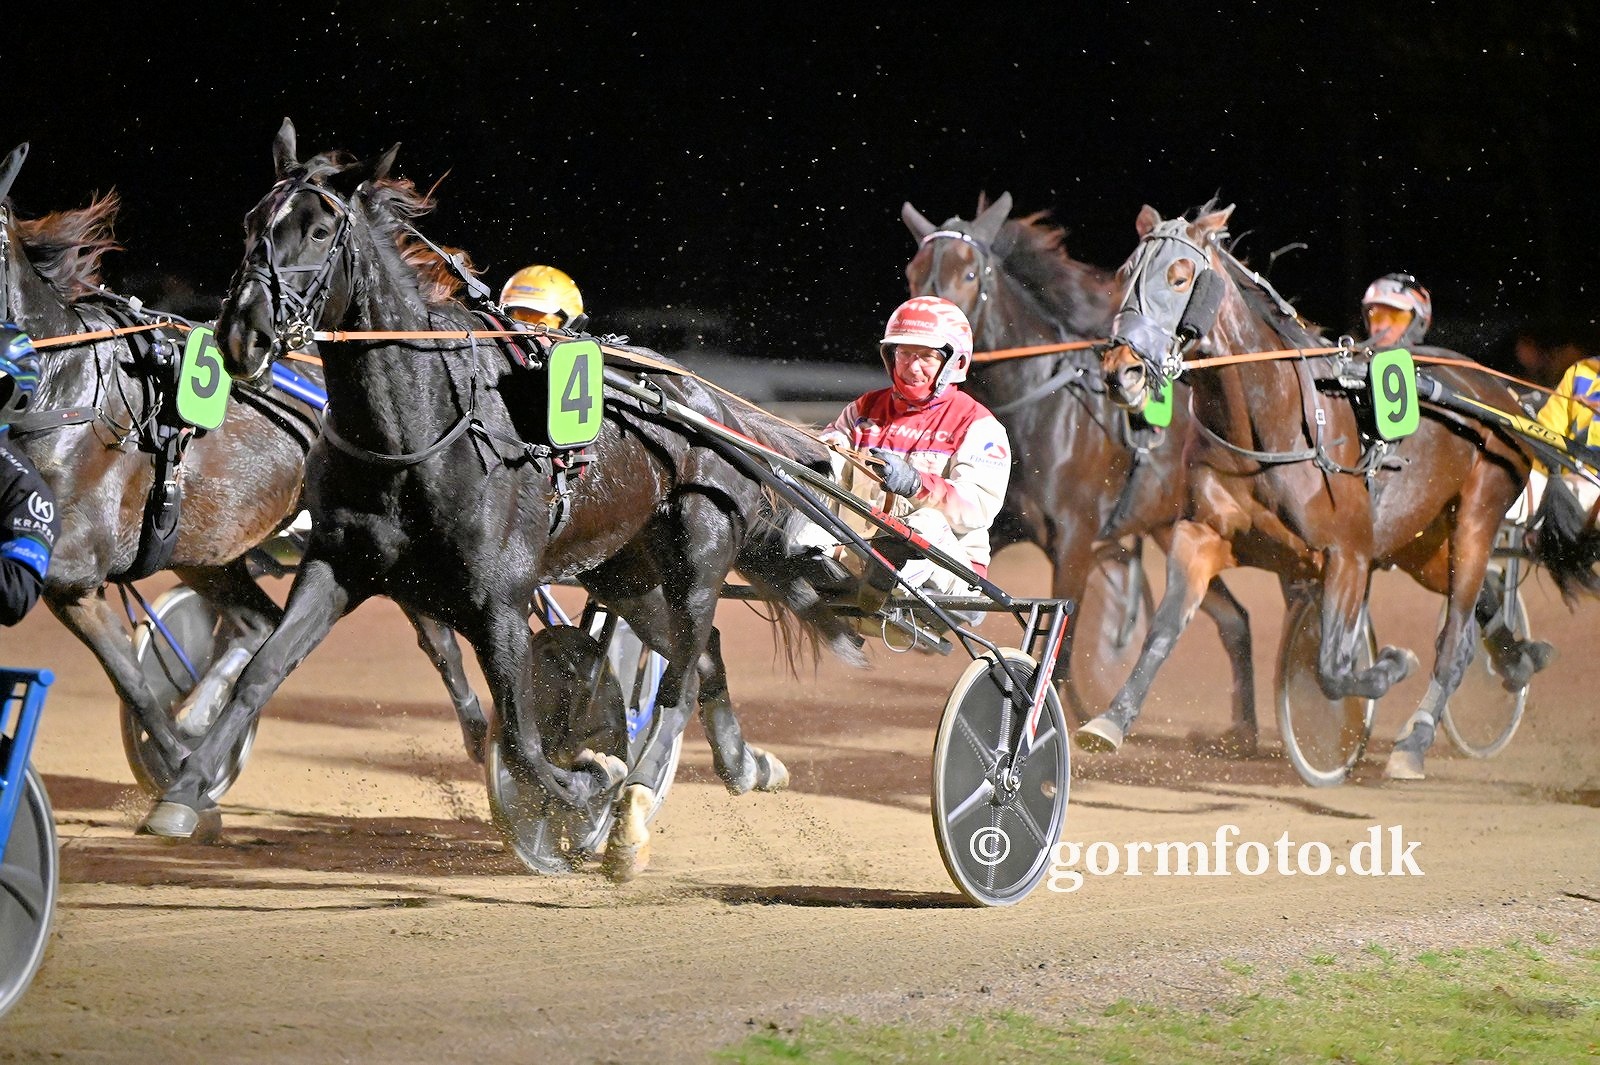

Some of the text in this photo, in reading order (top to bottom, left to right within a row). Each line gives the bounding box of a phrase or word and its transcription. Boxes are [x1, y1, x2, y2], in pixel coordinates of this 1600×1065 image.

[191, 333, 220, 398] 5
[560, 354, 593, 424] 4
[1382, 363, 1408, 423] 9
